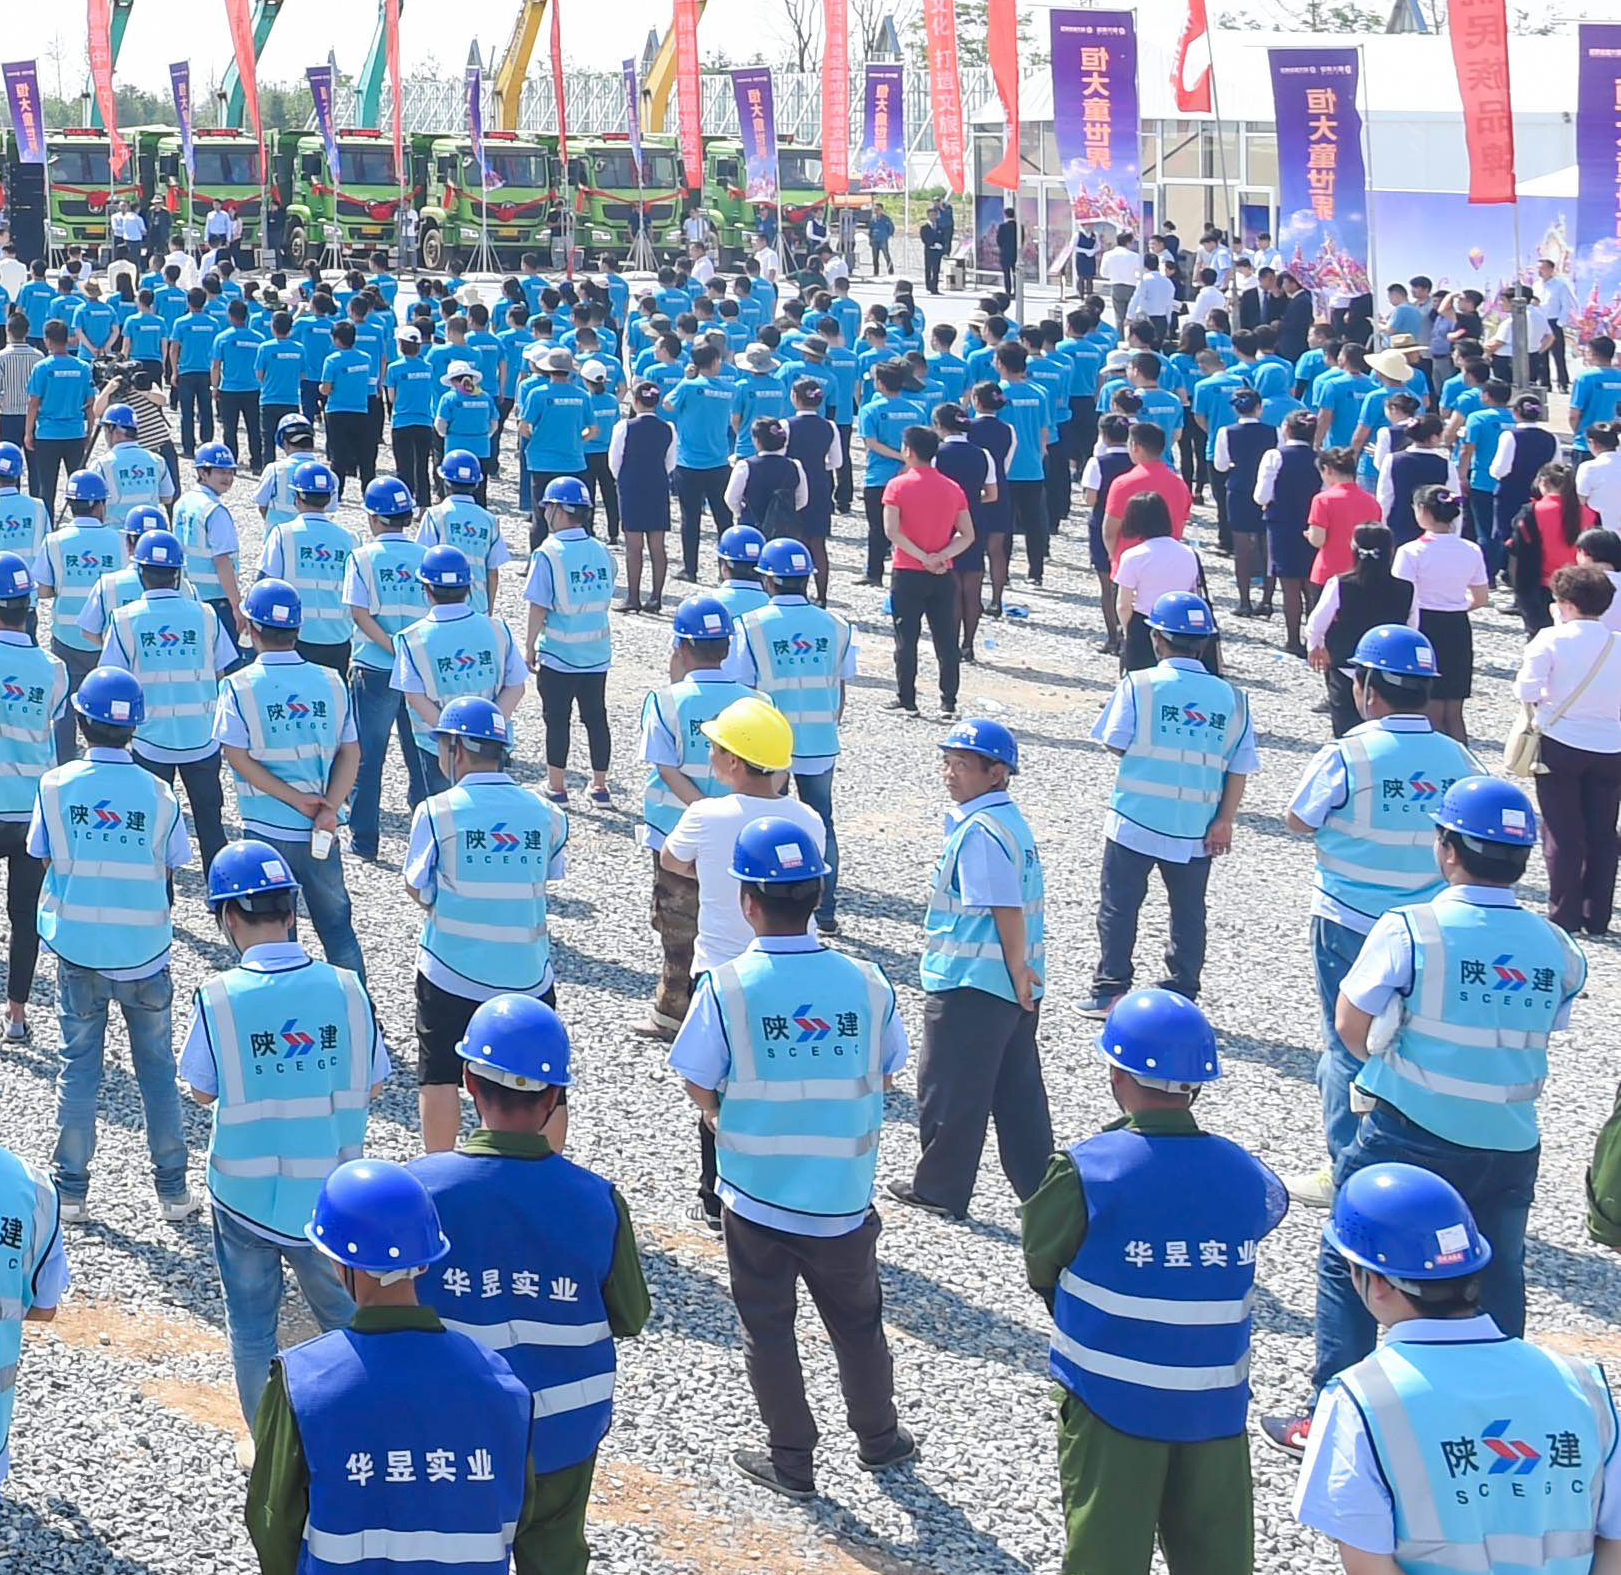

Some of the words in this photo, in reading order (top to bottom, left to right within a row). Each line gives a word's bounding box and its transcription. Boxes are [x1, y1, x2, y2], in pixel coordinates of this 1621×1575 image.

[70, 800, 145, 831] 陕建
[467, 823, 541, 853] 陕建
[1460, 953, 1555, 994] 陕建
[1460, 991, 1552, 1009] SCEGC
[251, 1019, 338, 1058] 陕建
[762, 1004, 859, 1044] 陕建
[254, 1056, 337, 1075] SCEGC
[1124, 1241, 1257, 1267] 华昱实业
[443, 1267, 579, 1303] 华昱实业
[1441, 1419, 1582, 1478] 陕建
[347, 1448, 495, 1486] 华昱实业
[1457, 1478, 1582, 1505] SCEGC
